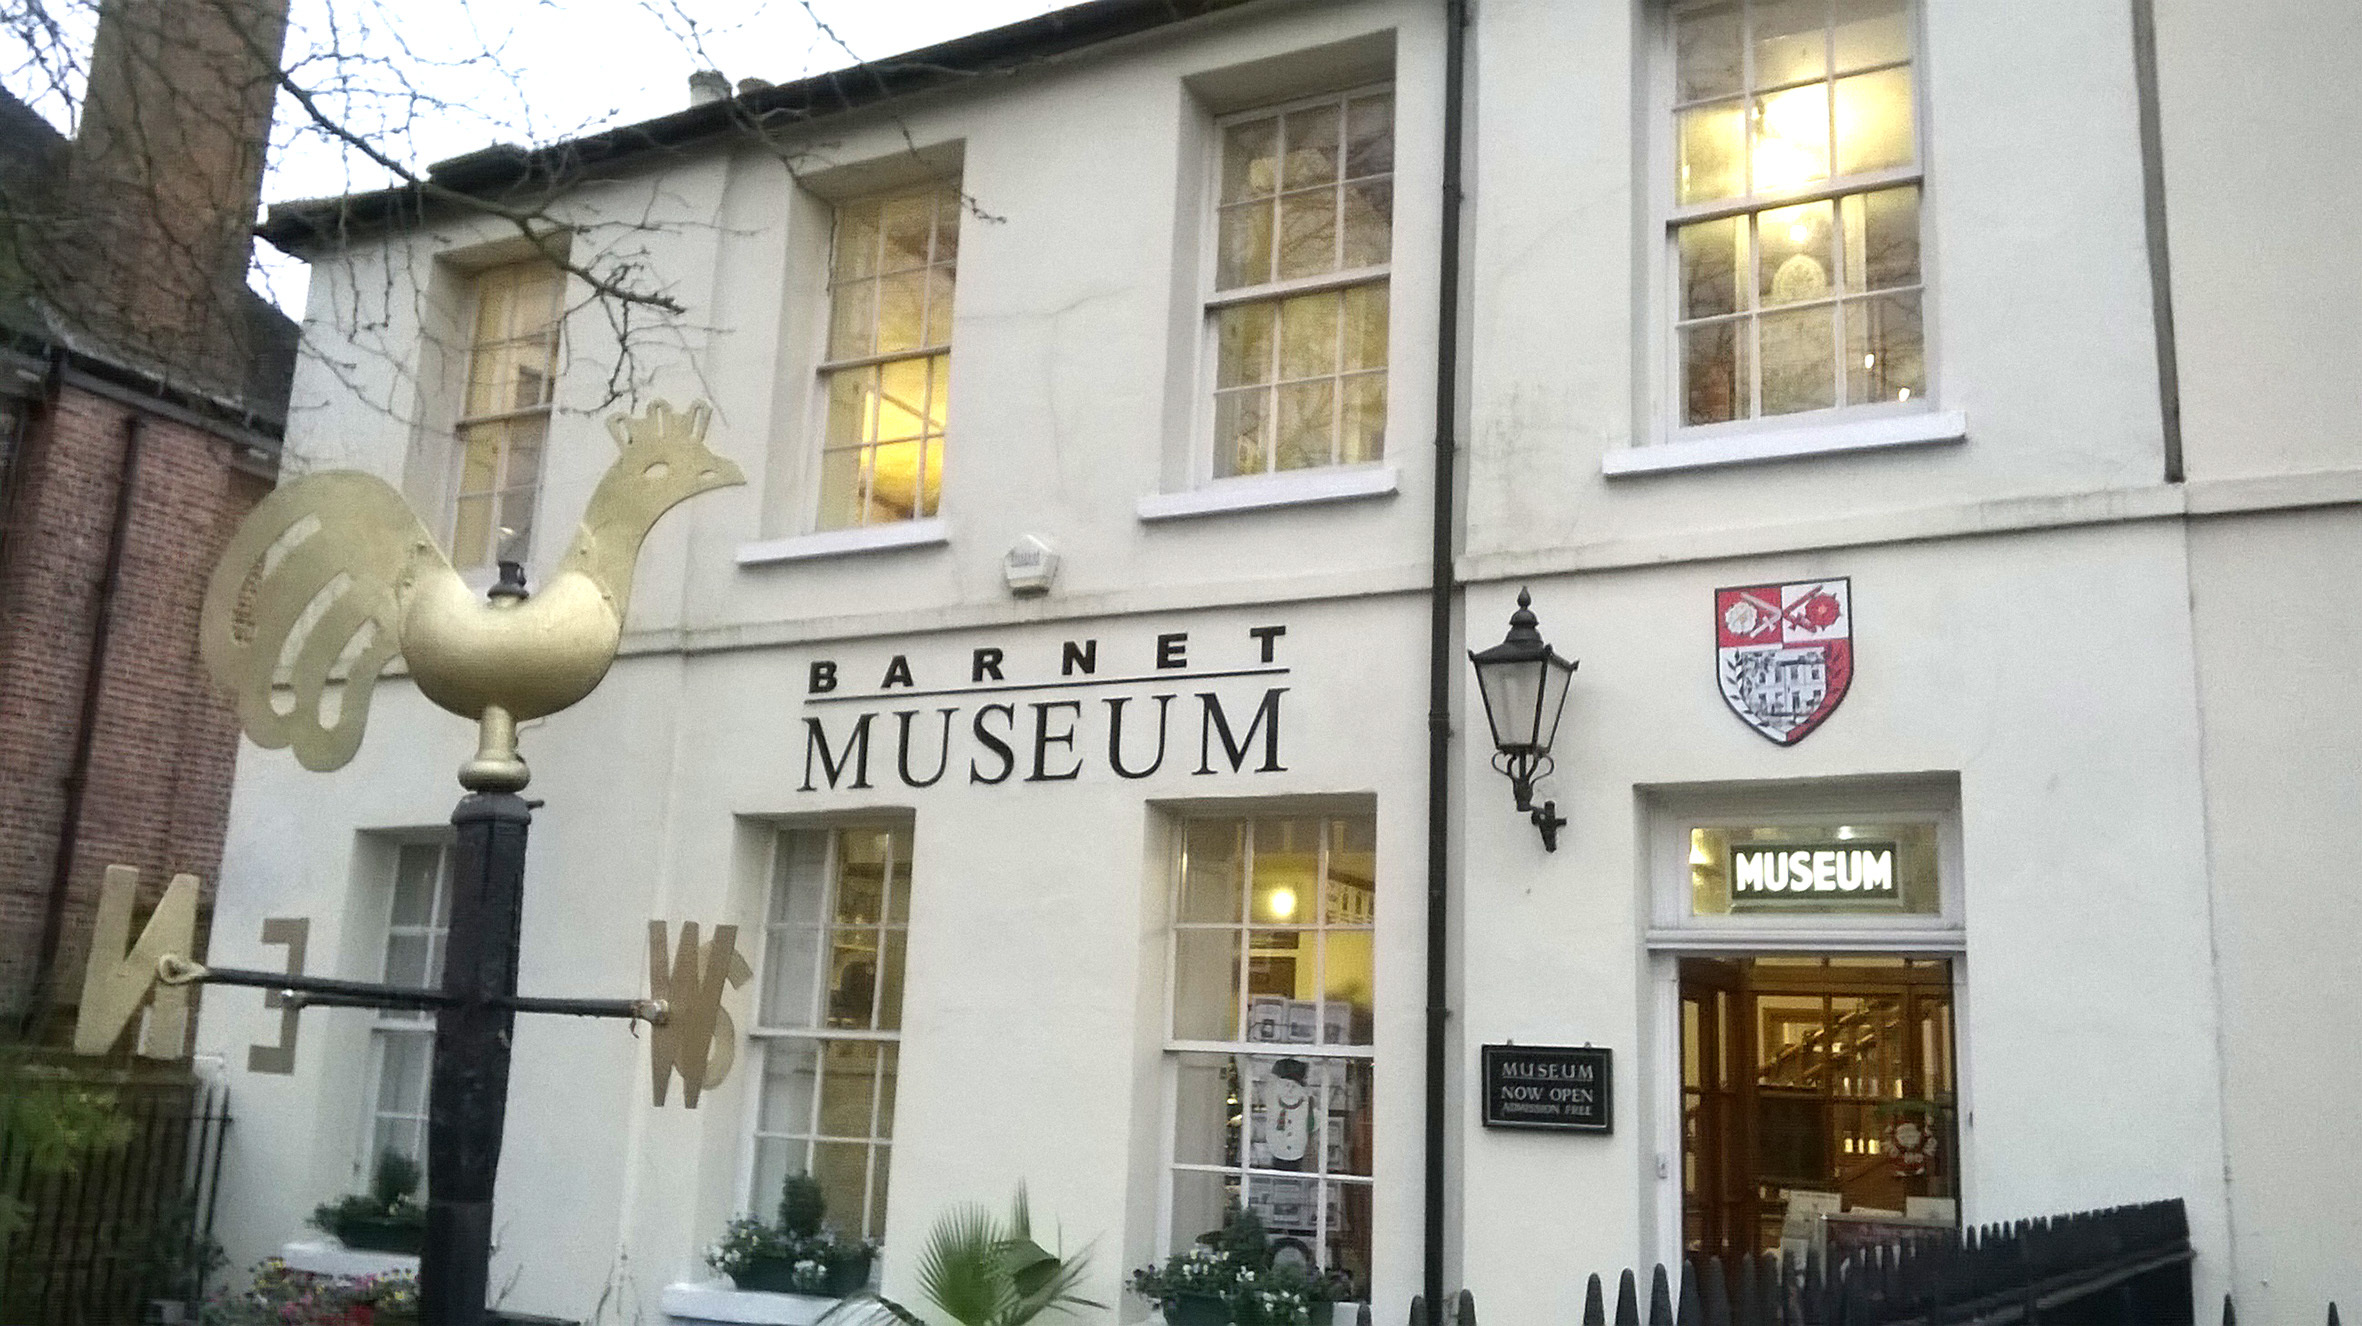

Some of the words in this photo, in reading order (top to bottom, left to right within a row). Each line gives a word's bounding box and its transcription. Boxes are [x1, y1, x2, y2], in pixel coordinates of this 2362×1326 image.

[807, 625, 1286, 695] BARNET
[796, 687, 1291, 792] MUSEUM
[1735, 850, 1892, 892] MUSEUM
[649, 920, 738, 1109] W
[1502, 1062, 1594, 1080] MUSEUM
[1501, 1085, 1544, 1101] NOW
[1550, 1087, 1594, 1103] OPEN
[1565, 1104, 1592, 1116] FREE
